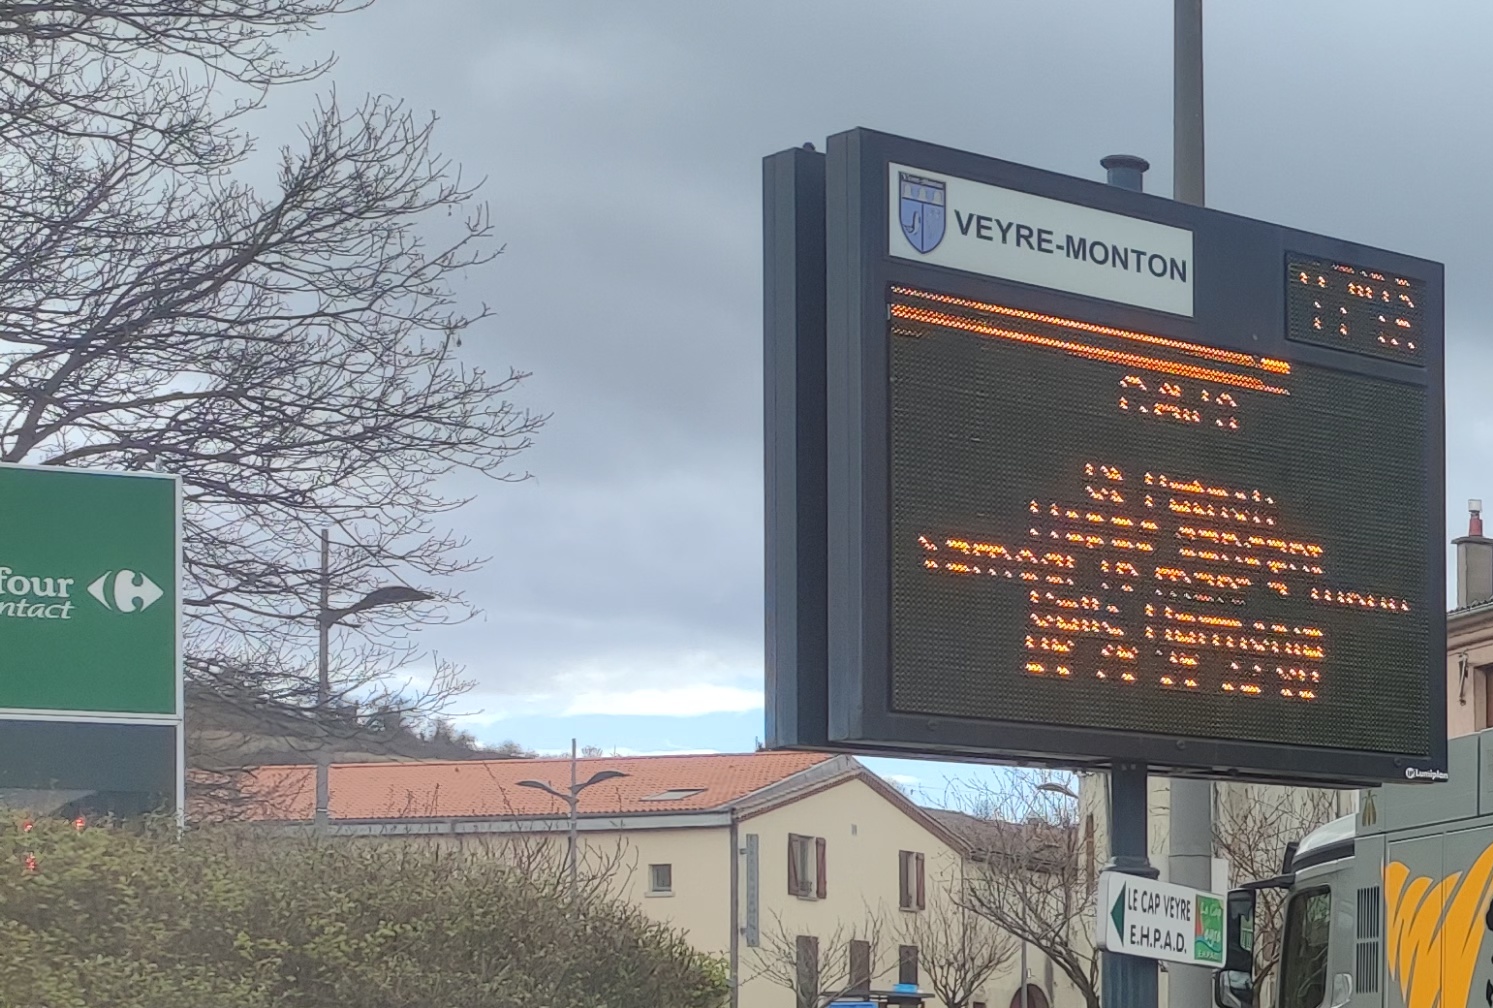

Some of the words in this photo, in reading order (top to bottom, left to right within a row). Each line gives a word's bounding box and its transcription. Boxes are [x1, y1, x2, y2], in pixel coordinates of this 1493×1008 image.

[954, 209, 1187, 283] VEYRE-MONTON
[1415, 768, 1449, 780] Lumiplan
[1128, 887, 1138, 911] LE
[1140, 889, 1161, 915] CAP
[1163, 894, 1191, 922] VEYRE
[1130, 924, 1187, 954] E.H.P.A.D.
